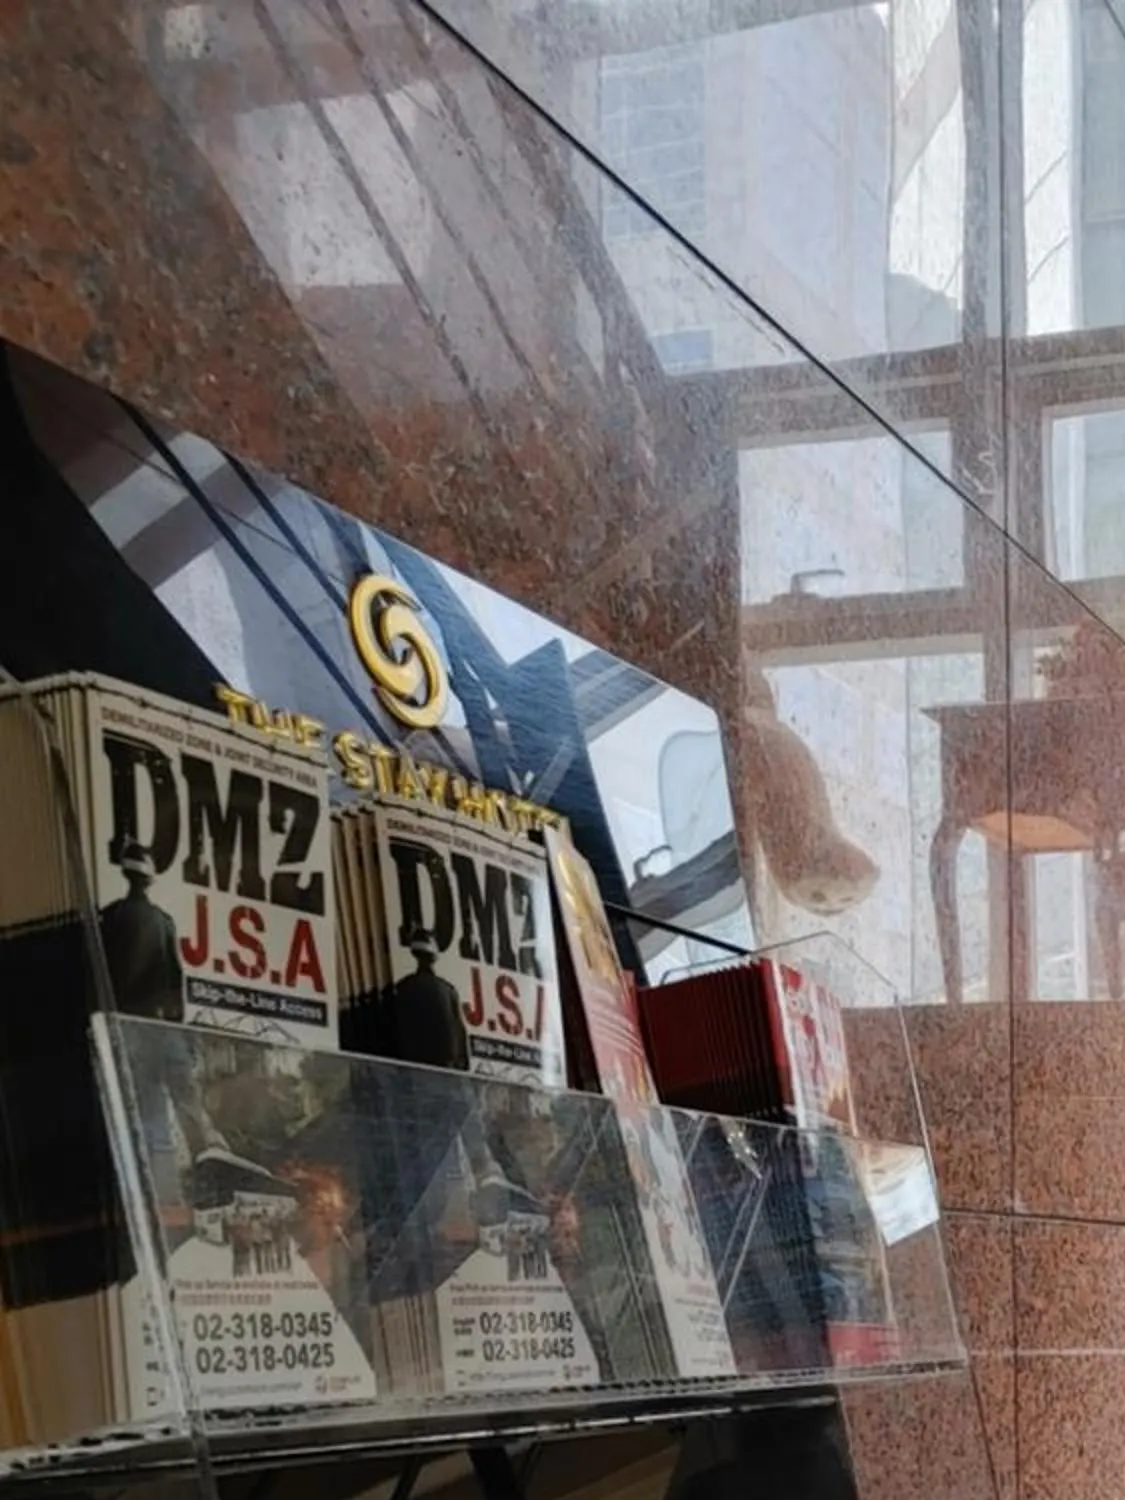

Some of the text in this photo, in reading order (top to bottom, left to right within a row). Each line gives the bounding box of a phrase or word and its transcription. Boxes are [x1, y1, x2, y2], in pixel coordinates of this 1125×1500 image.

[102, 727, 325, 918] DMZ
[179, 893, 327, 994] J.S.A
[193, 1311, 333, 1342] 02-318-0345
[196, 1343, 336, 1374] 02-318-0425
